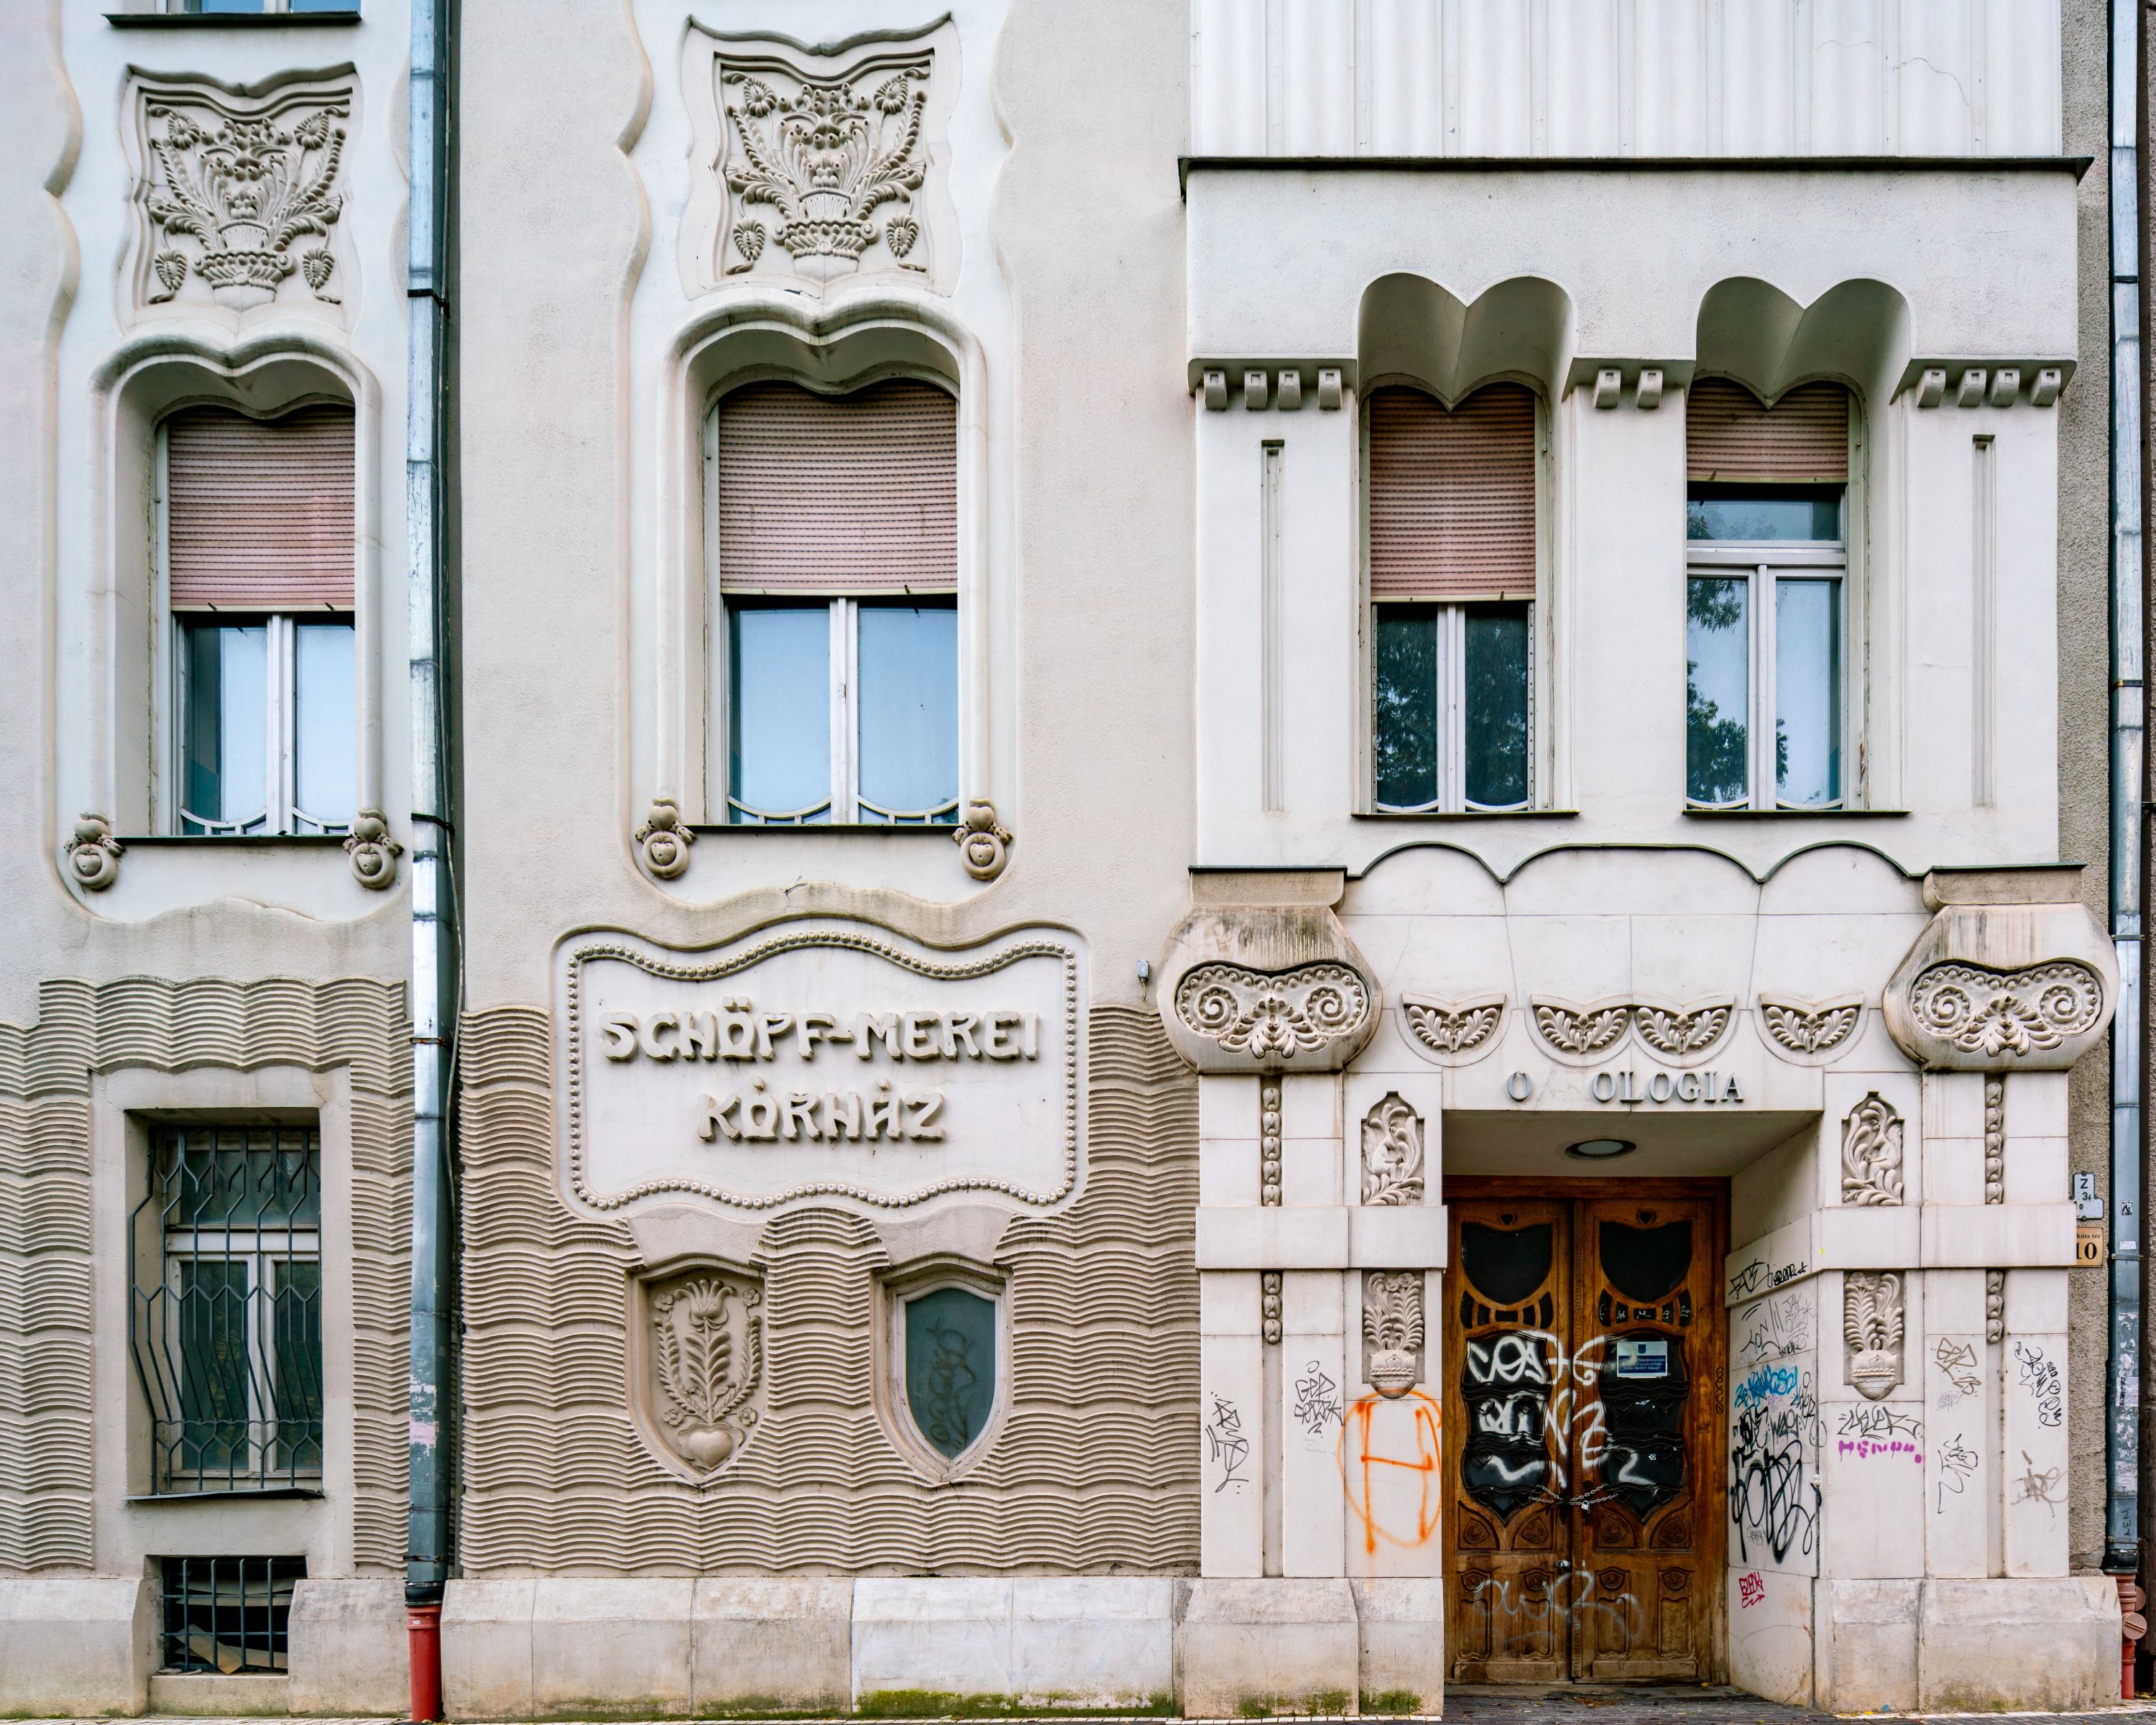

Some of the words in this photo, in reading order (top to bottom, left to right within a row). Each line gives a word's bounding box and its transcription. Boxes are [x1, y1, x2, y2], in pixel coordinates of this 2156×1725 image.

[599, 996, 1039, 1062] SCHÖPF-MEREI
[696, 1075, 946, 1141] KÓRHÁZ
[2080, 1179, 2088, 1189] Z
[2076, 1242, 2097, 1259] 10
